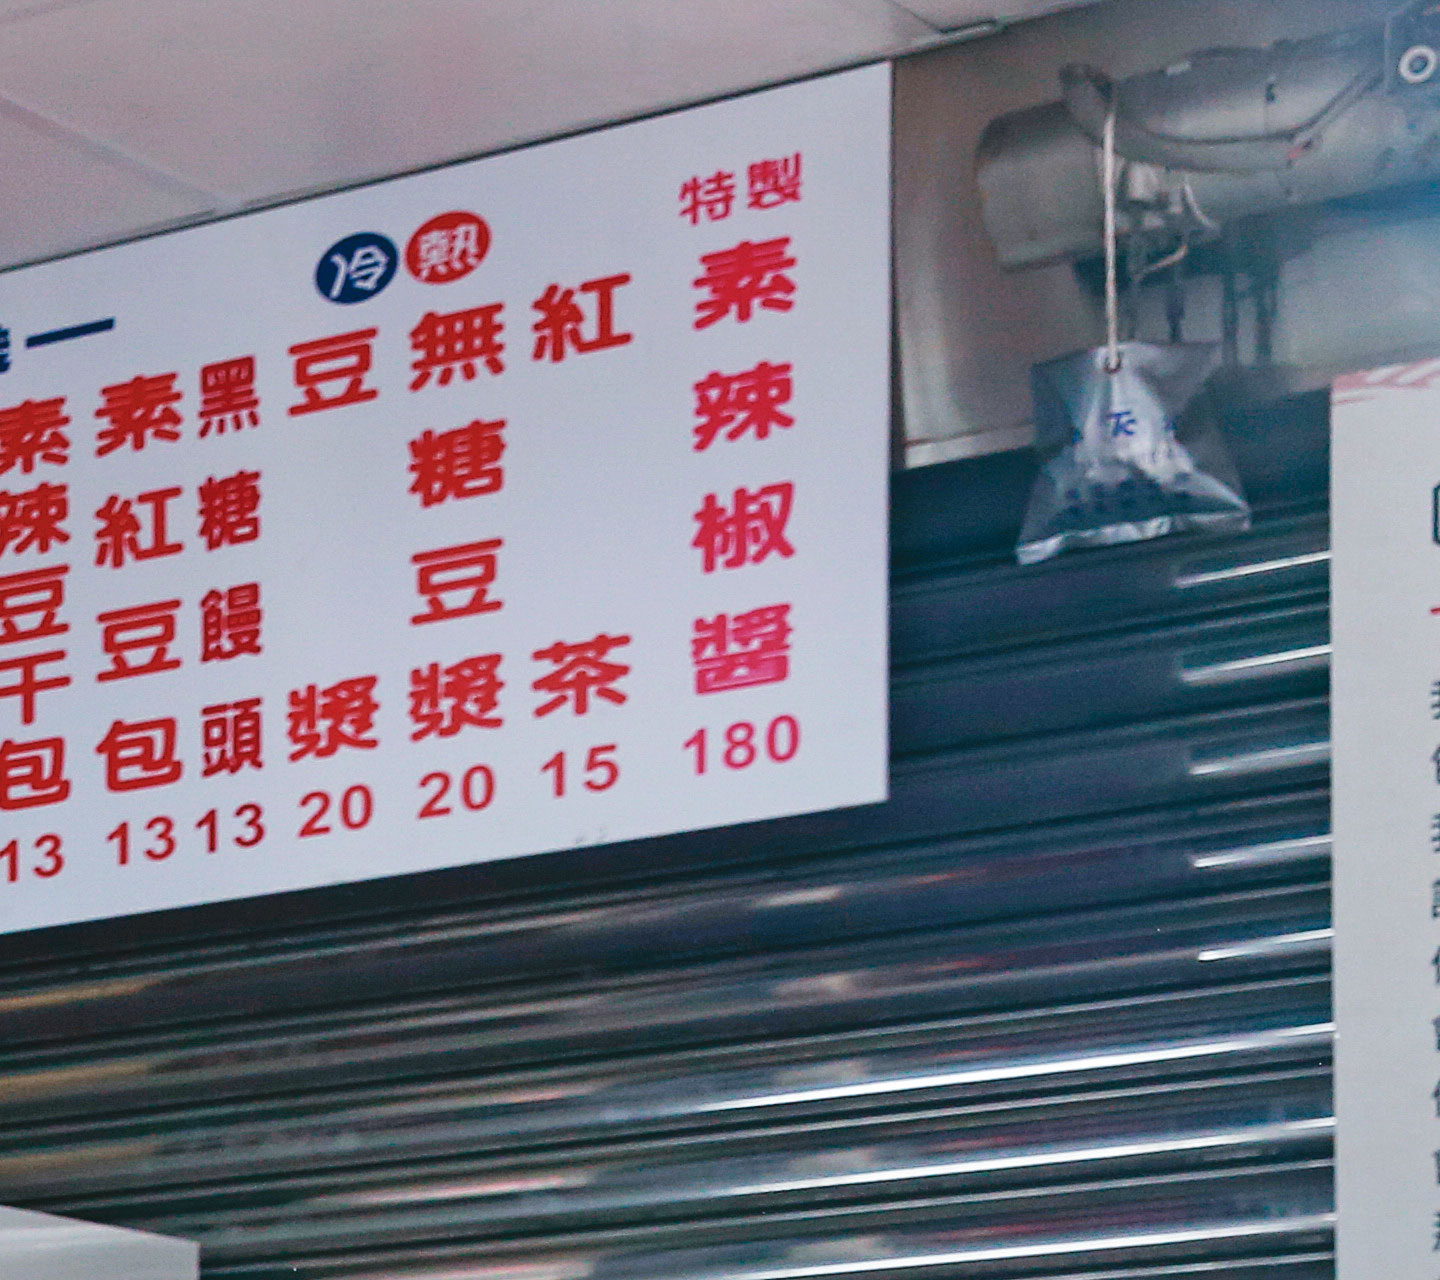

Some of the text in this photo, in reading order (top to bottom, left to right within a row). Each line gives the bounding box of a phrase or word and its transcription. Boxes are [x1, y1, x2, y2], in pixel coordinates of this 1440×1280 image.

[329, 248, 389, 297] 冷
[417, 226, 480, 278] 熱
[678, 151, 804, 227] 特製
[94, 371, 183, 865] 素紅豆包 13
[195, 354, 265, 853] 黑糖饅頭 13
[286, 326, 379, 838] 豆漿 20
[407, 301, 507, 820] 無糖豆漿 20
[531, 272, 633, 798] 紅茶 15
[683, 235, 800, 776] 素辣椒醬 180
